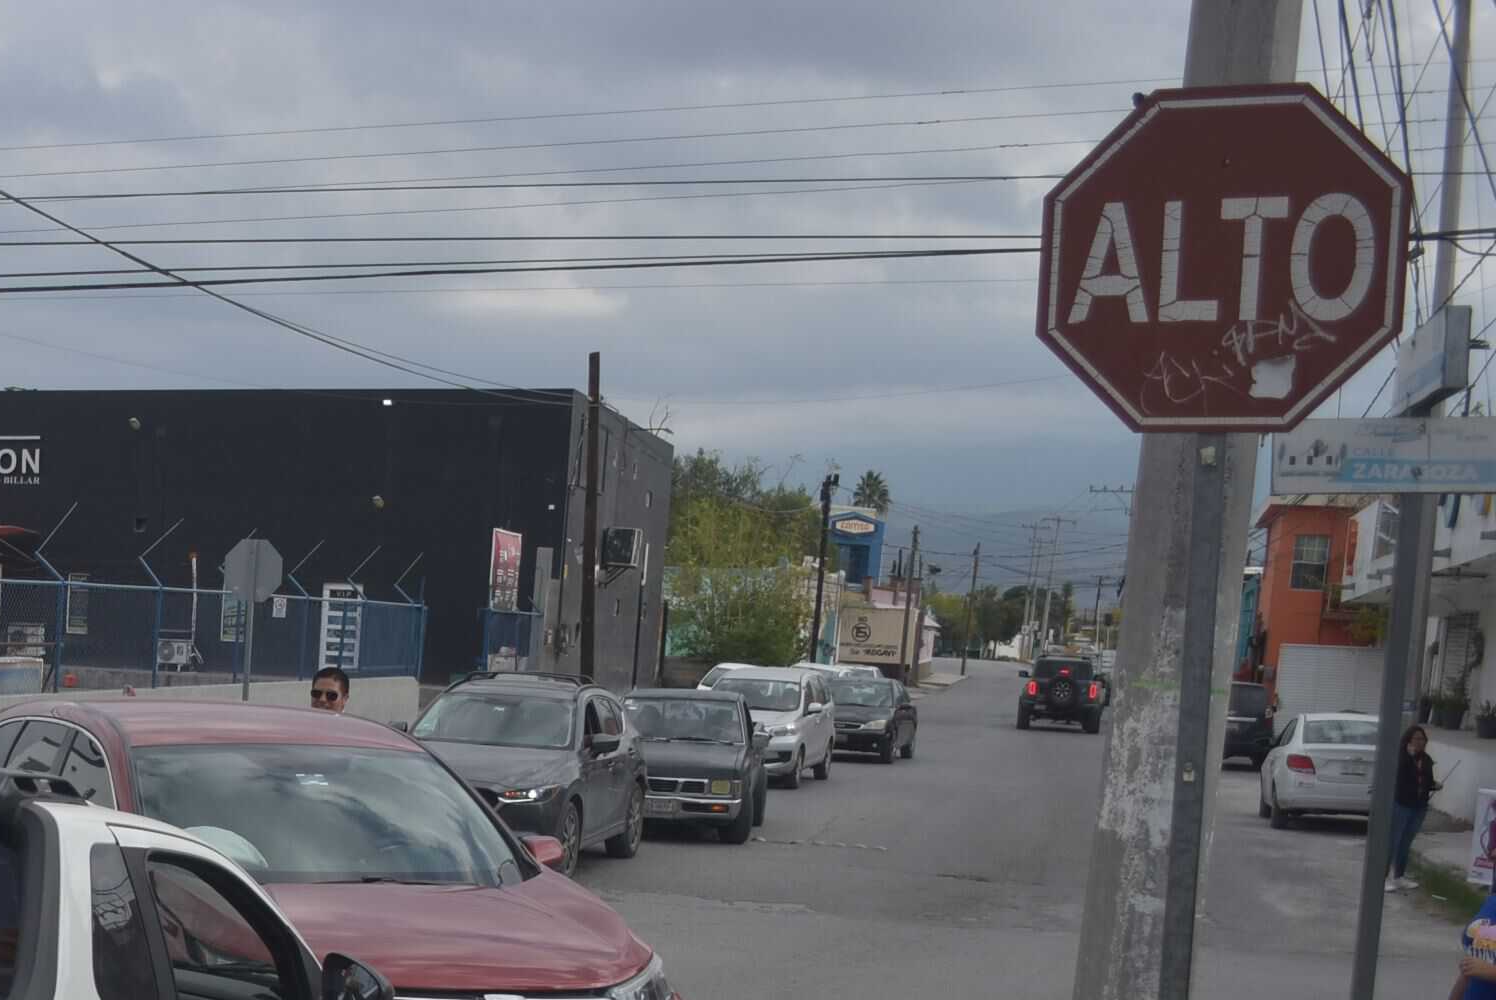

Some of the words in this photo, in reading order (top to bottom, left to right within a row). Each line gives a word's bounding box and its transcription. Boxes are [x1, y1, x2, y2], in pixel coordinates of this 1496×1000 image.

[1067, 192, 1375, 324] ALTO
[3, 475, 40, 485] BILLAR
[1352, 463, 1481, 480] ZARAGOZA
